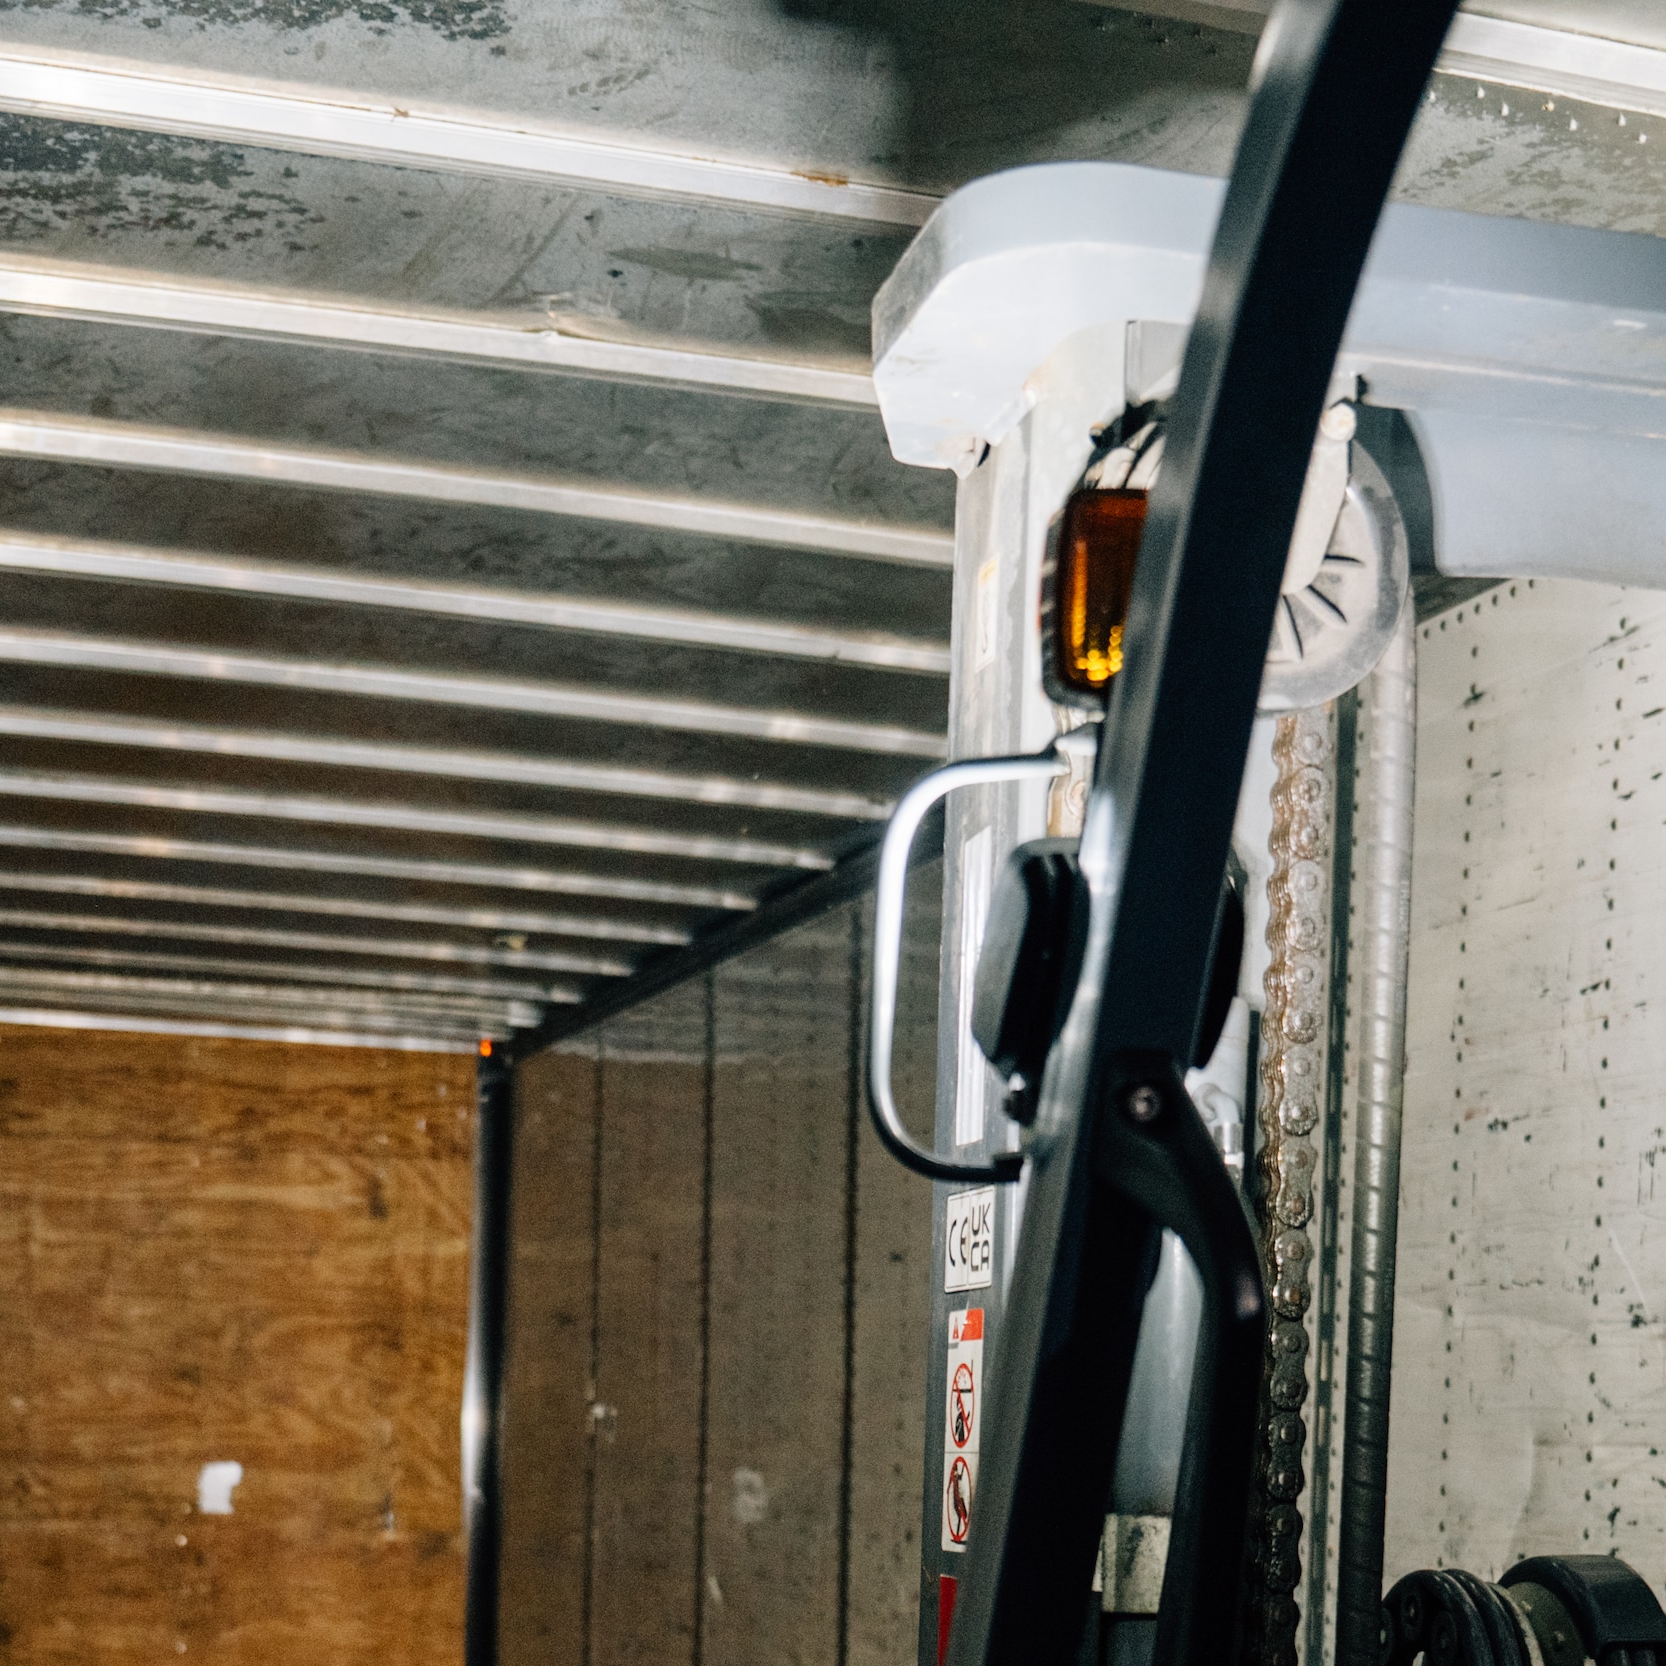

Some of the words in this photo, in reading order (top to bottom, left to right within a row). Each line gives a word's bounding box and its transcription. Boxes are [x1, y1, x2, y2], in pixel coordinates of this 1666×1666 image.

[971, 1202, 991, 1236] UK
[949, 1216, 968, 1267] CE
[970, 1239, 990, 1272] CA
